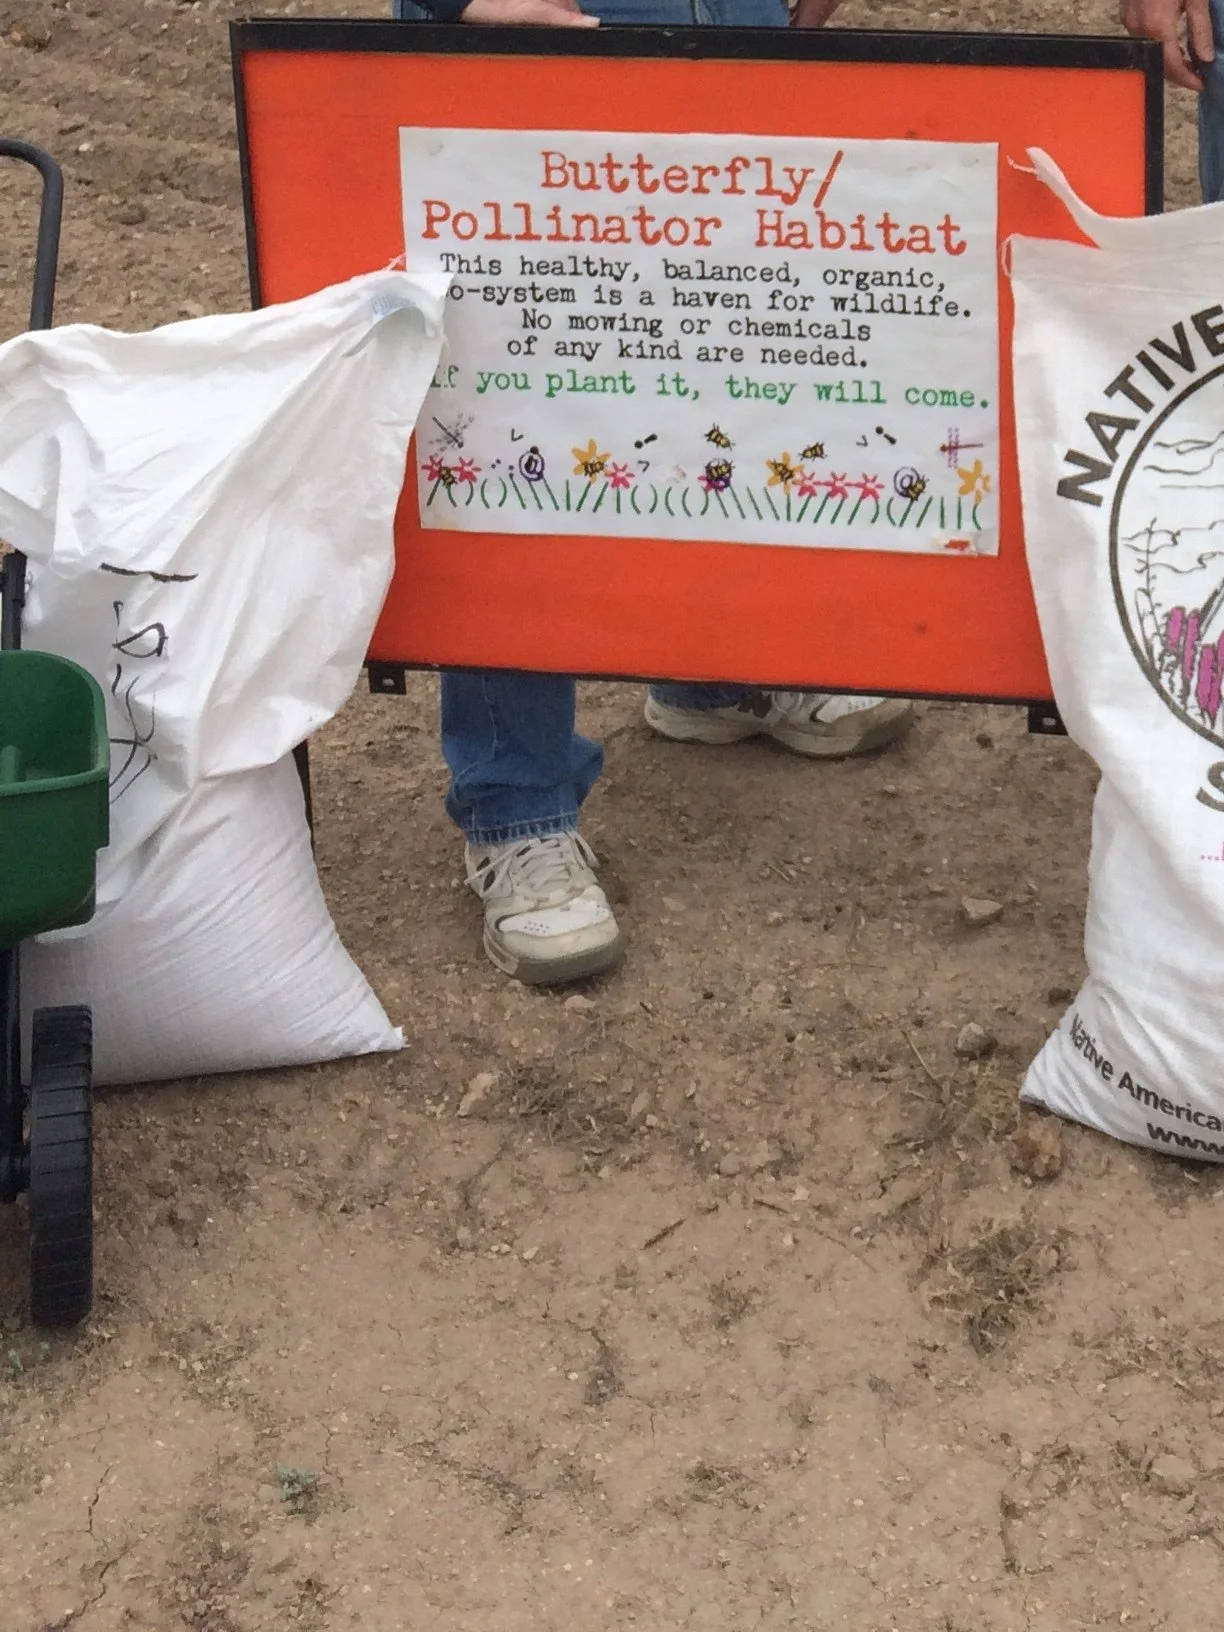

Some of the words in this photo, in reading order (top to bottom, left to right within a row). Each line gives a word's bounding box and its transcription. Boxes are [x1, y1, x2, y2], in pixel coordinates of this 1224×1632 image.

[541, 150, 844, 210] Butterfly/
[422, 200, 722, 247] Pollinator
[755, 204, 967, 256] Habitat
[440, 252, 502, 276] This
[519, 255, 640, 285] healthy,
[662, 258, 801, 287] balanced,
[823, 267, 945, 292] organic,
[446, 282, 576, 306] o-system
[594, 285, 622, 305] is
[639, 291, 655, 306] a
[672, 287, 751, 310] haven
[767, 289, 815, 311] for
[830, 290, 972, 317] wildlife.
[522, 308, 552, 330] No
[568, 313, 663, 338] mowing
[680, 318, 711, 336] or
[728, 317, 871, 341] chemicals
[507, 335, 538, 356] of
[554, 342, 601, 362] any
[617, 339, 682, 360] kind
[696, 345, 744, 364] are
[761, 345, 867, 368] needed.
[476, 372, 531, 394] you
[545, 370, 636, 398] plant
[656, 372, 700, 401] it,
[725, 373, 797, 404] they
[814, 379, 886, 404] will
[904, 387, 989, 409] come.
[1069, 1013, 1114, 1081] Native
